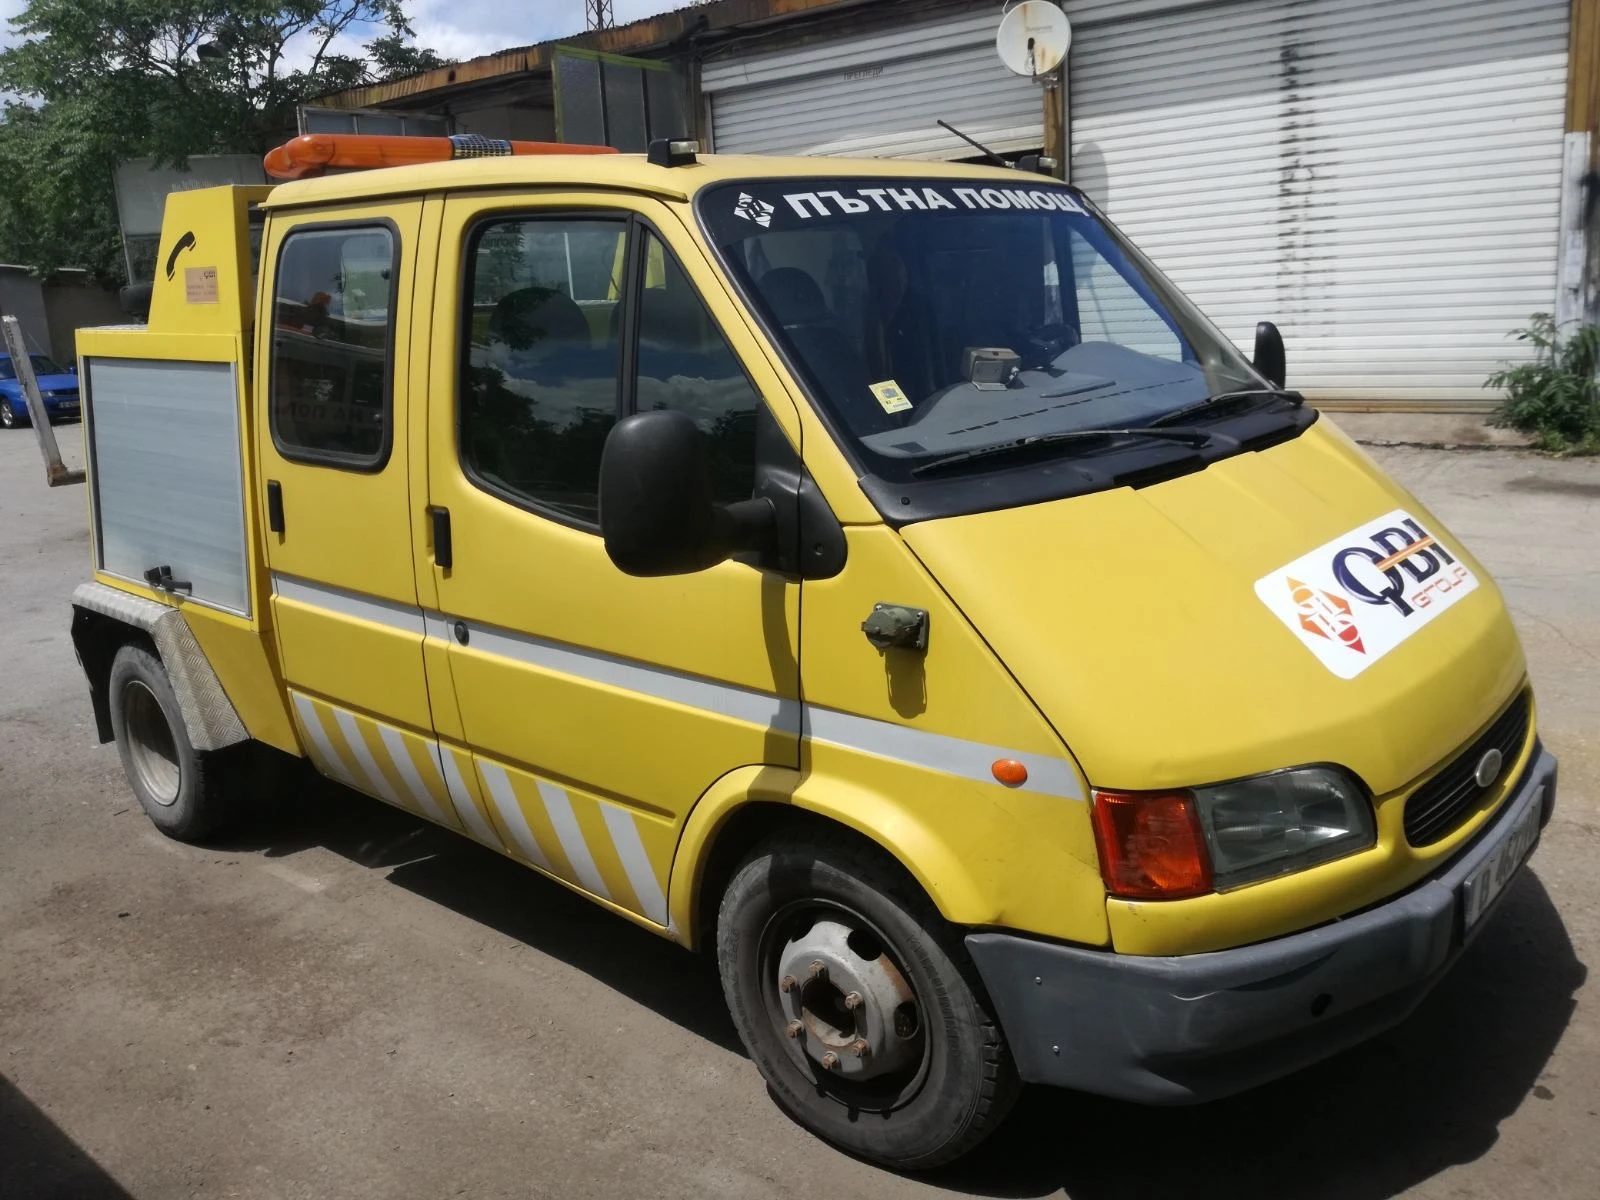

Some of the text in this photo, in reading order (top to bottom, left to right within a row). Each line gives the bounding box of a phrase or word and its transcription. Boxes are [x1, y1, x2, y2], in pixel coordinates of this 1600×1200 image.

[783, 188, 1090, 219] ПЪТНА ПОМОЩ
[1332, 518, 1455, 618] QBI
